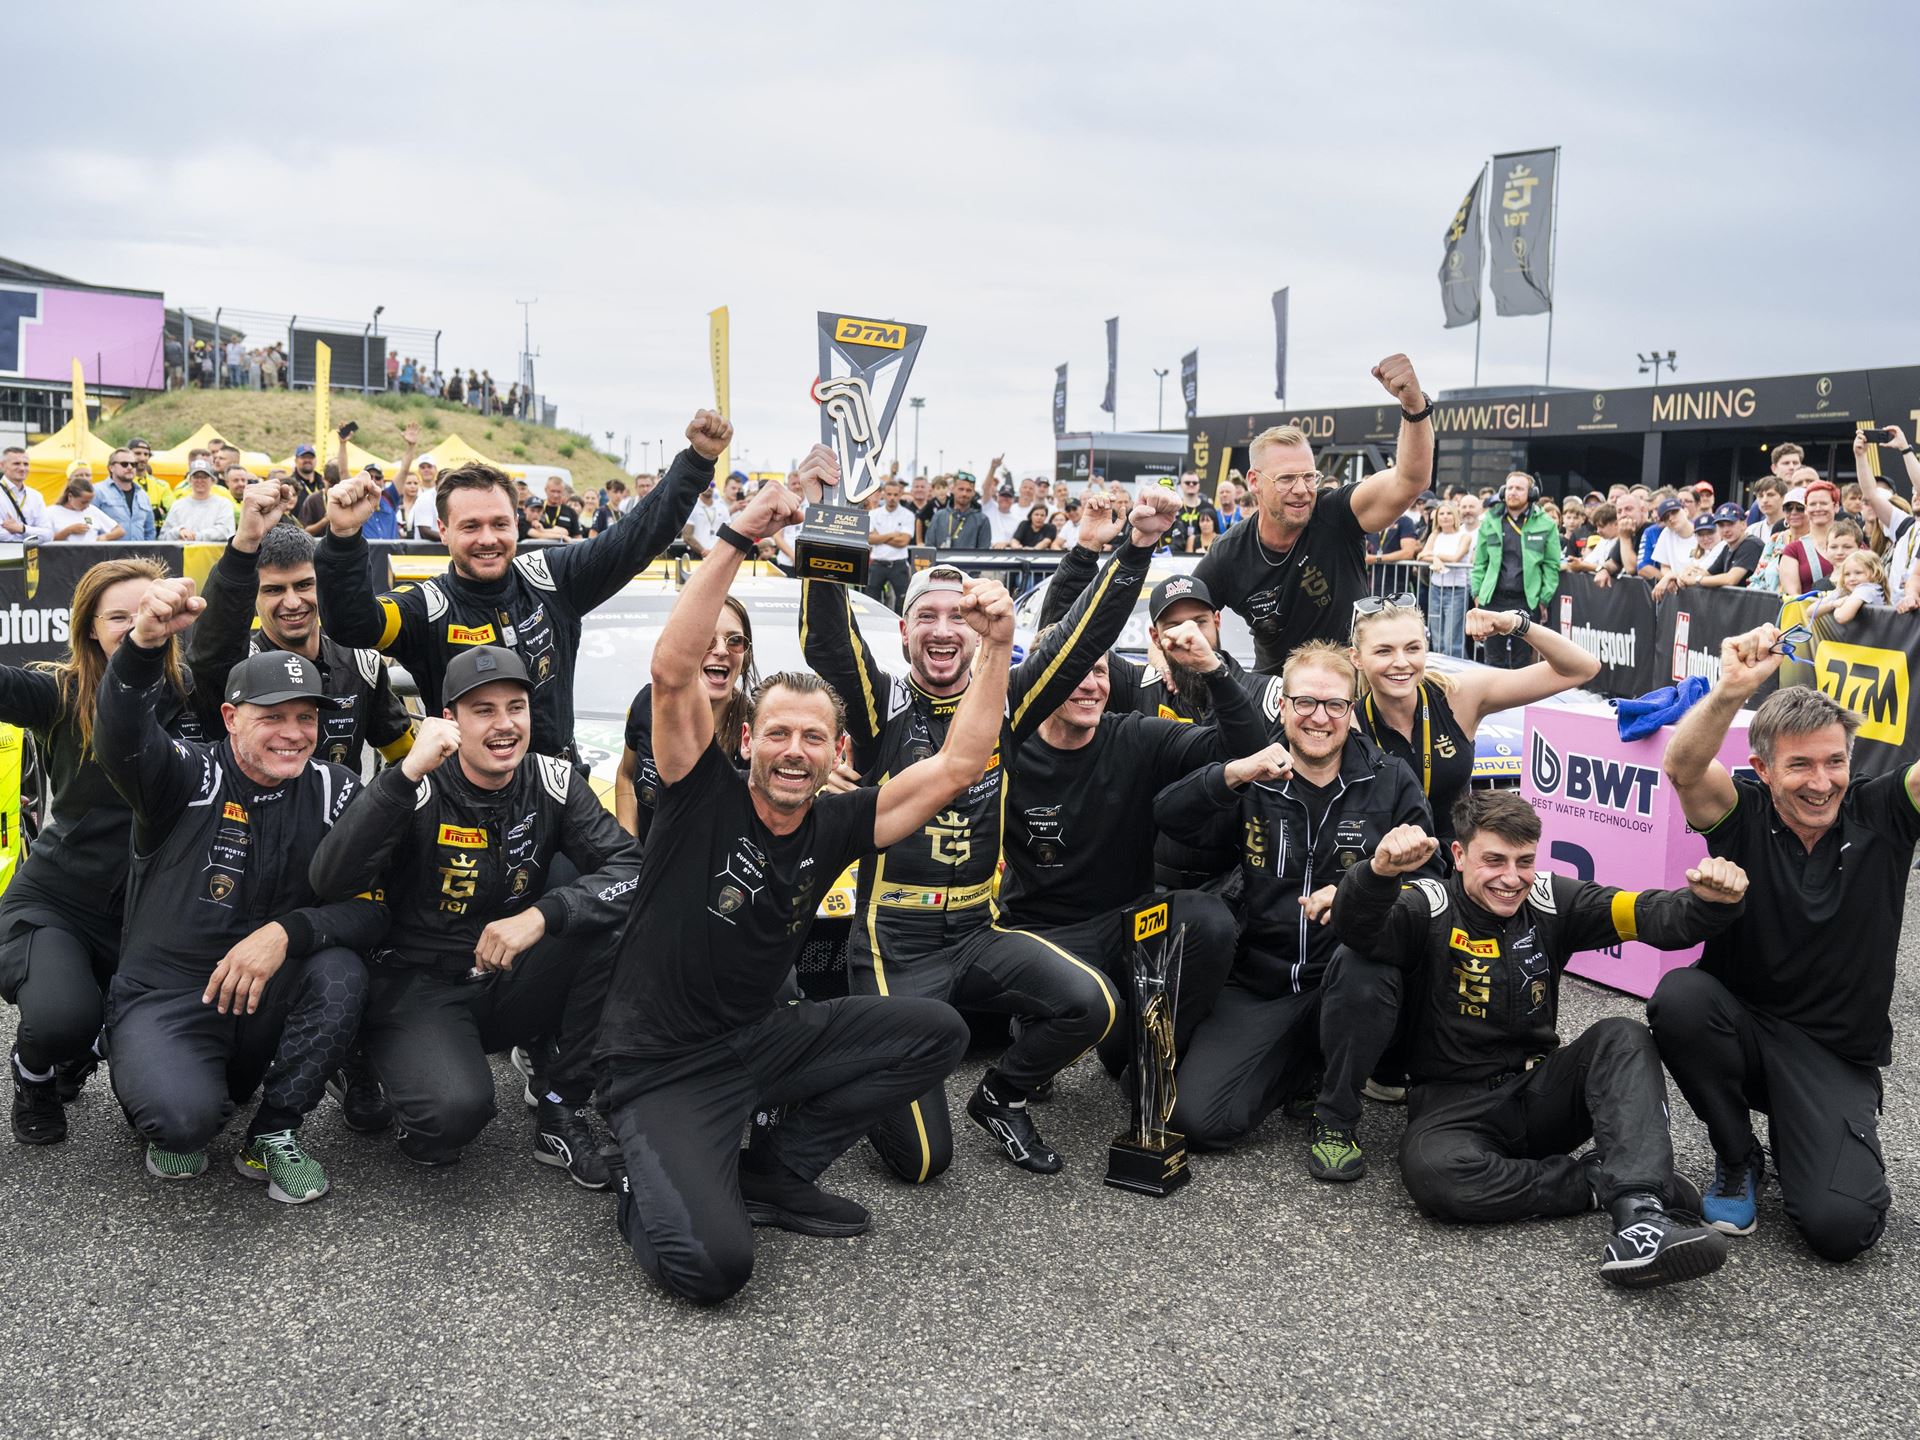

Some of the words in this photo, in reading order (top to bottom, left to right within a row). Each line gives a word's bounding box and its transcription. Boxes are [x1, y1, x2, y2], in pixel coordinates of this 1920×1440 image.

[840, 322, 901, 346] DTM
[1652, 387, 1757, 423] MINING
[813, 560, 850, 571] DTM
[0, 602, 70, 646] otors
[452, 628, 490, 642] PIRELLI
[933, 705, 958, 715] DTM
[1566, 753, 1660, 816] BWT
[1531, 797, 1553, 811] BEST
[1555, 802, 1586, 818] WATER
[1588, 809, 1654, 834] TECHNOLOGY
[1138, 909, 1165, 937] DTM
[1458, 1001, 1487, 1019] TGI
